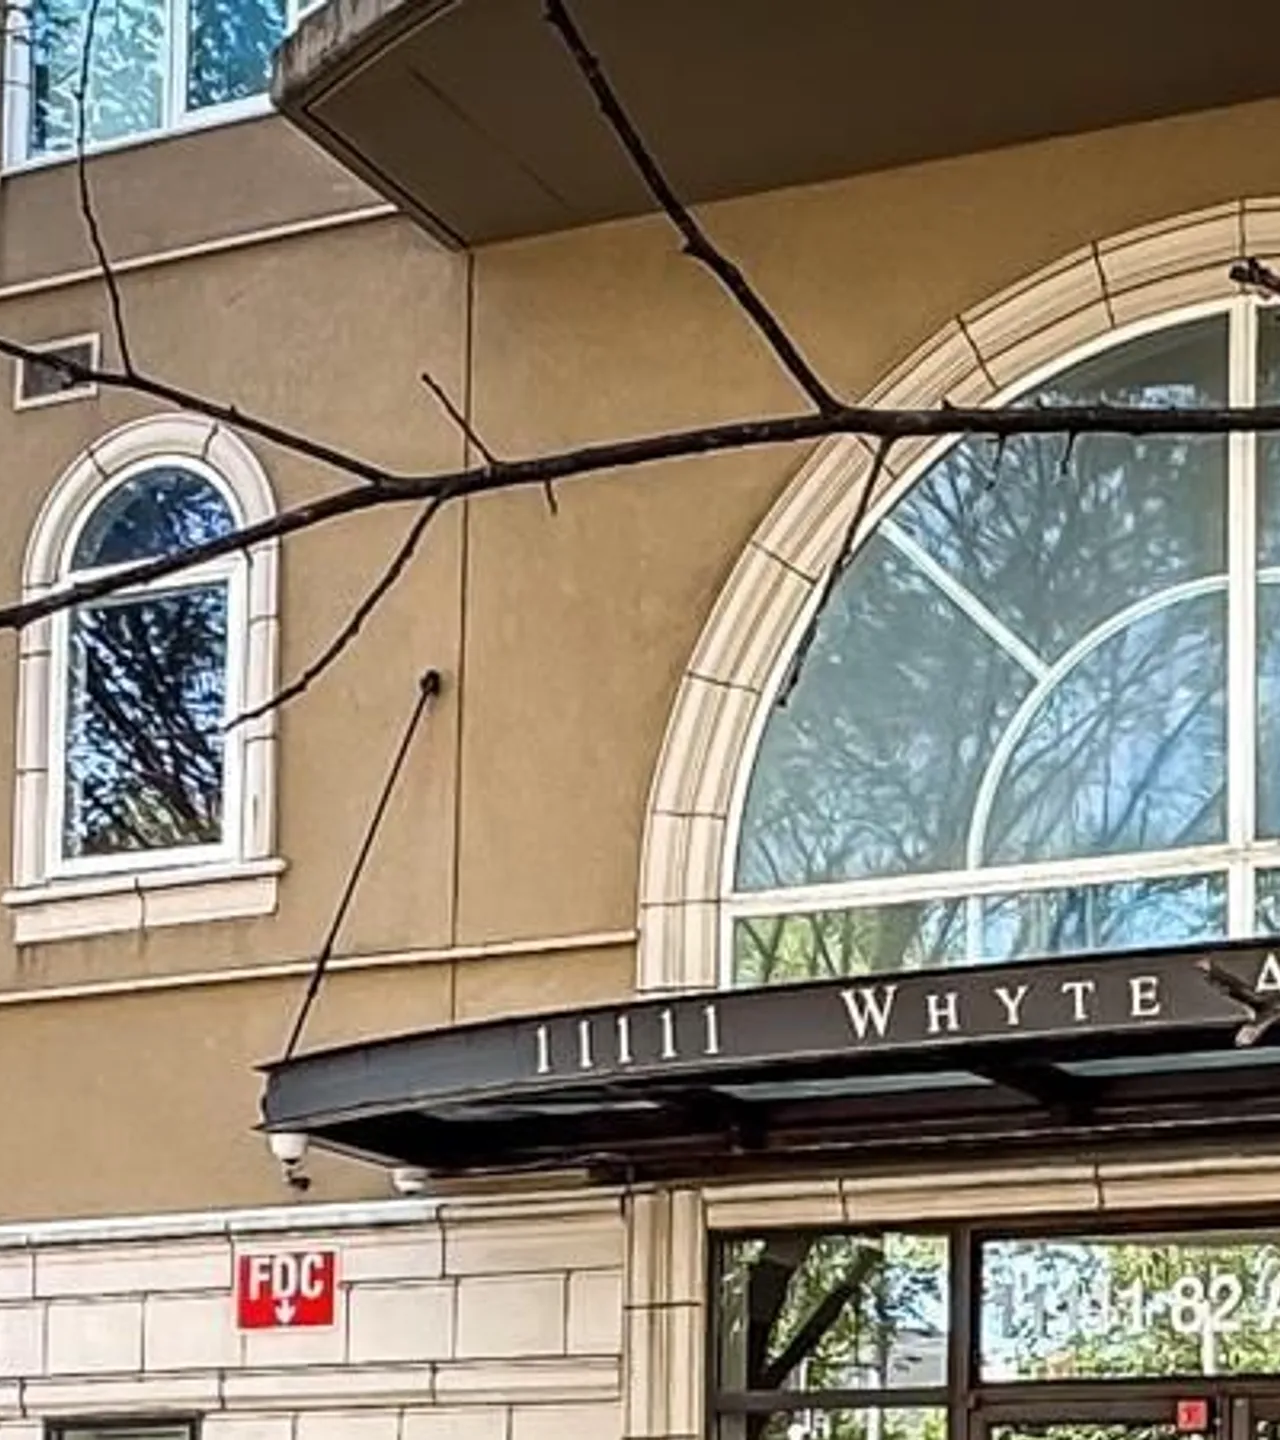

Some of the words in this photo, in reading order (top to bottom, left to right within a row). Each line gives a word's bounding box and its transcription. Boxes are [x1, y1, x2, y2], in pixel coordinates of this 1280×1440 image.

[537, 1005, 719, 1074] 11111
[840, 972, 1160, 1041] WHYTE
[249, 1253, 324, 1301] FDC
